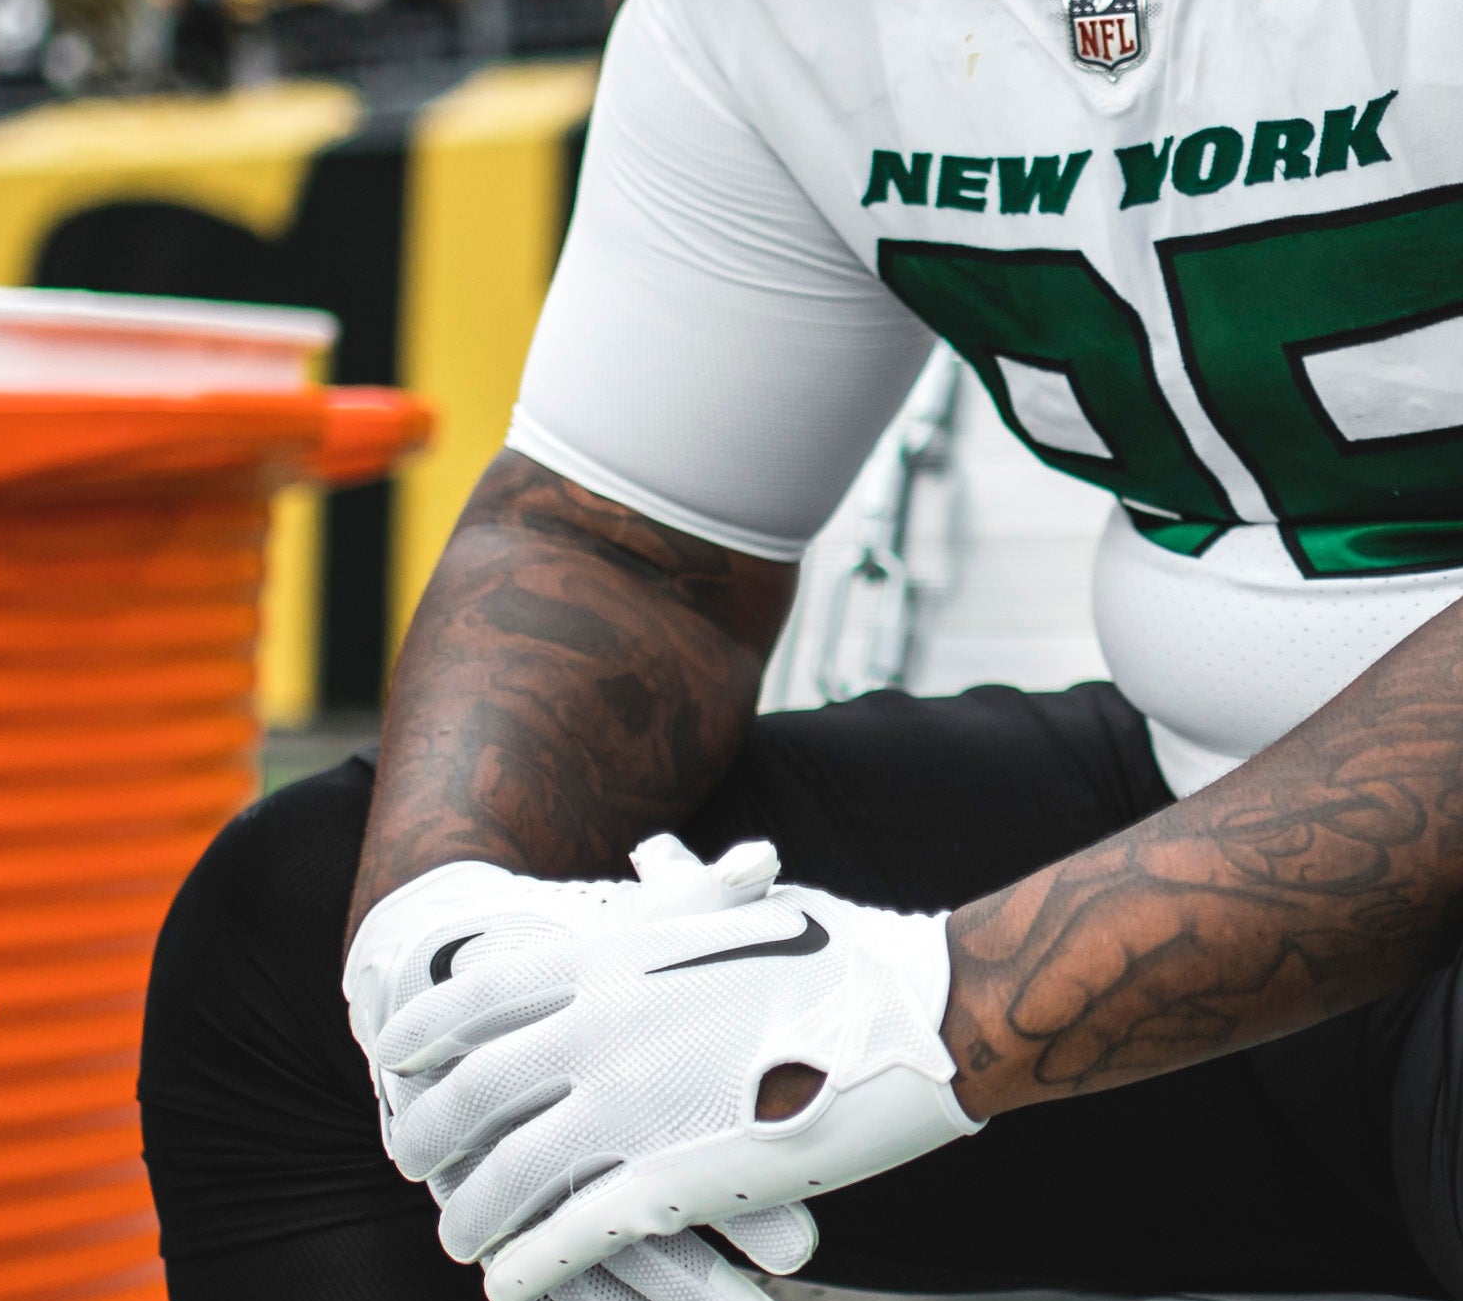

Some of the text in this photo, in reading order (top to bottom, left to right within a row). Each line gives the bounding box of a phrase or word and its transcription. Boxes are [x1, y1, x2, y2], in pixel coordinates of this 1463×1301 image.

[1076, 17, 1136, 62] NFL
[861, 89, 1399, 216] NEW YORK
